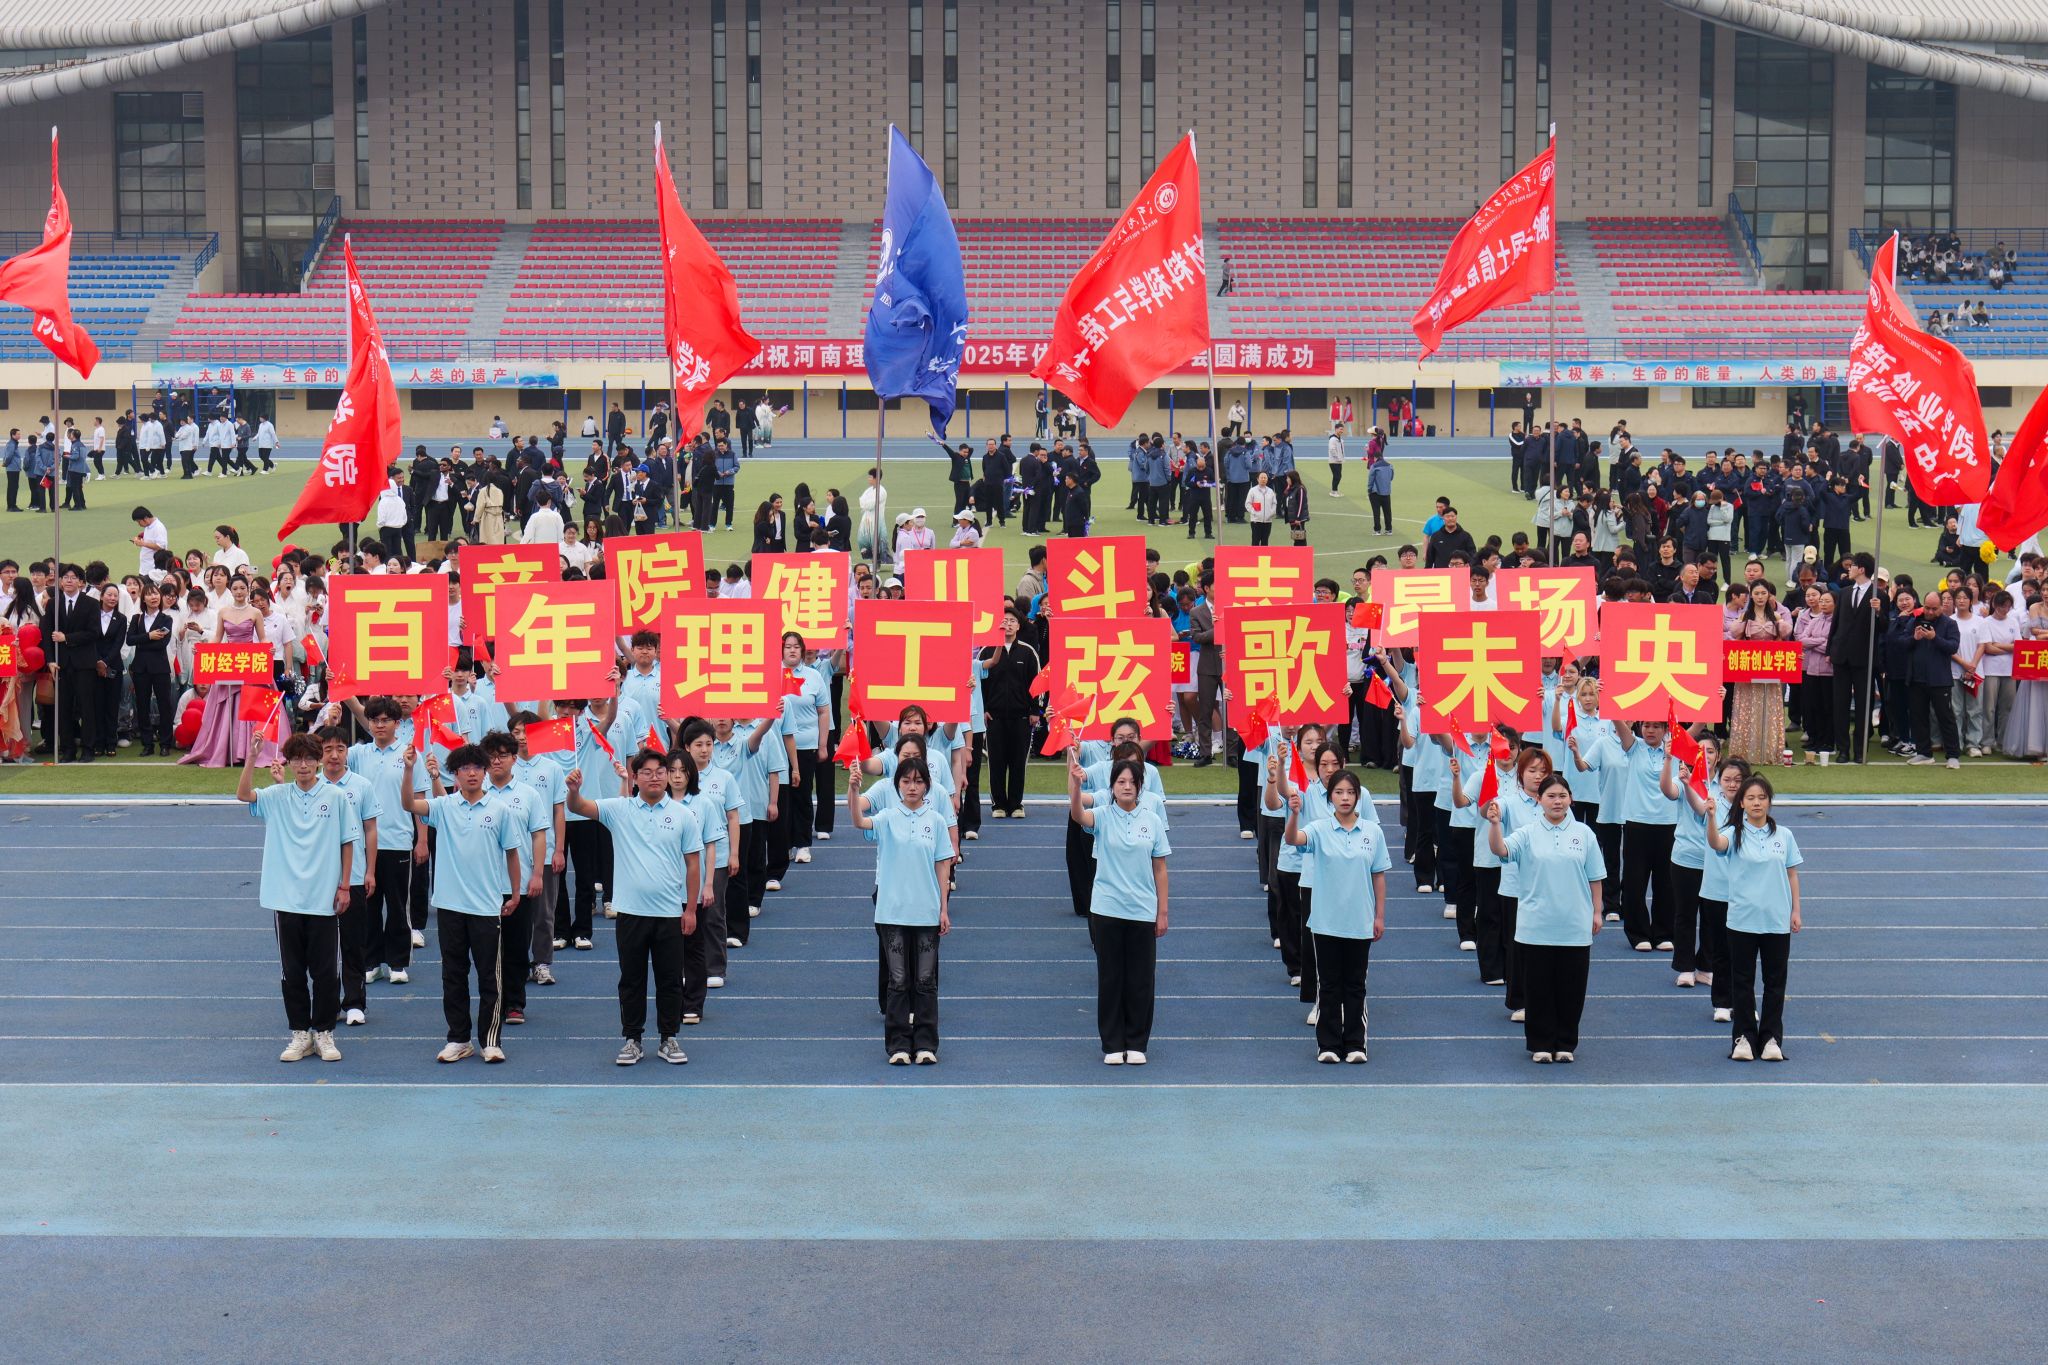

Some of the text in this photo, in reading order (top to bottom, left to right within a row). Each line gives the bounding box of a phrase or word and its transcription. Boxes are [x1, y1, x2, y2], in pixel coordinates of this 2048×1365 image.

[616, 542, 691, 627] 院
[763, 561, 838, 639] 健
[1062, 546, 1135, 618] 斗
[1508, 576, 1586, 649] 扬
[199, 652, 268, 673] 财经学院
[345, 589, 432, 680] 百
[509, 593, 601, 690] 年
[675, 613, 768, 703] 理
[866, 621, 956, 702] 工
[1239, 616, 1335, 714] 歌
[1434, 622, 1528, 723] 未
[1613, 614, 1709, 712] 央
[1728, 649, 1797, 671] 创新创业学院
[2018, 649, 2048, 670] 工商
[1066, 630, 1156, 727] 弦
